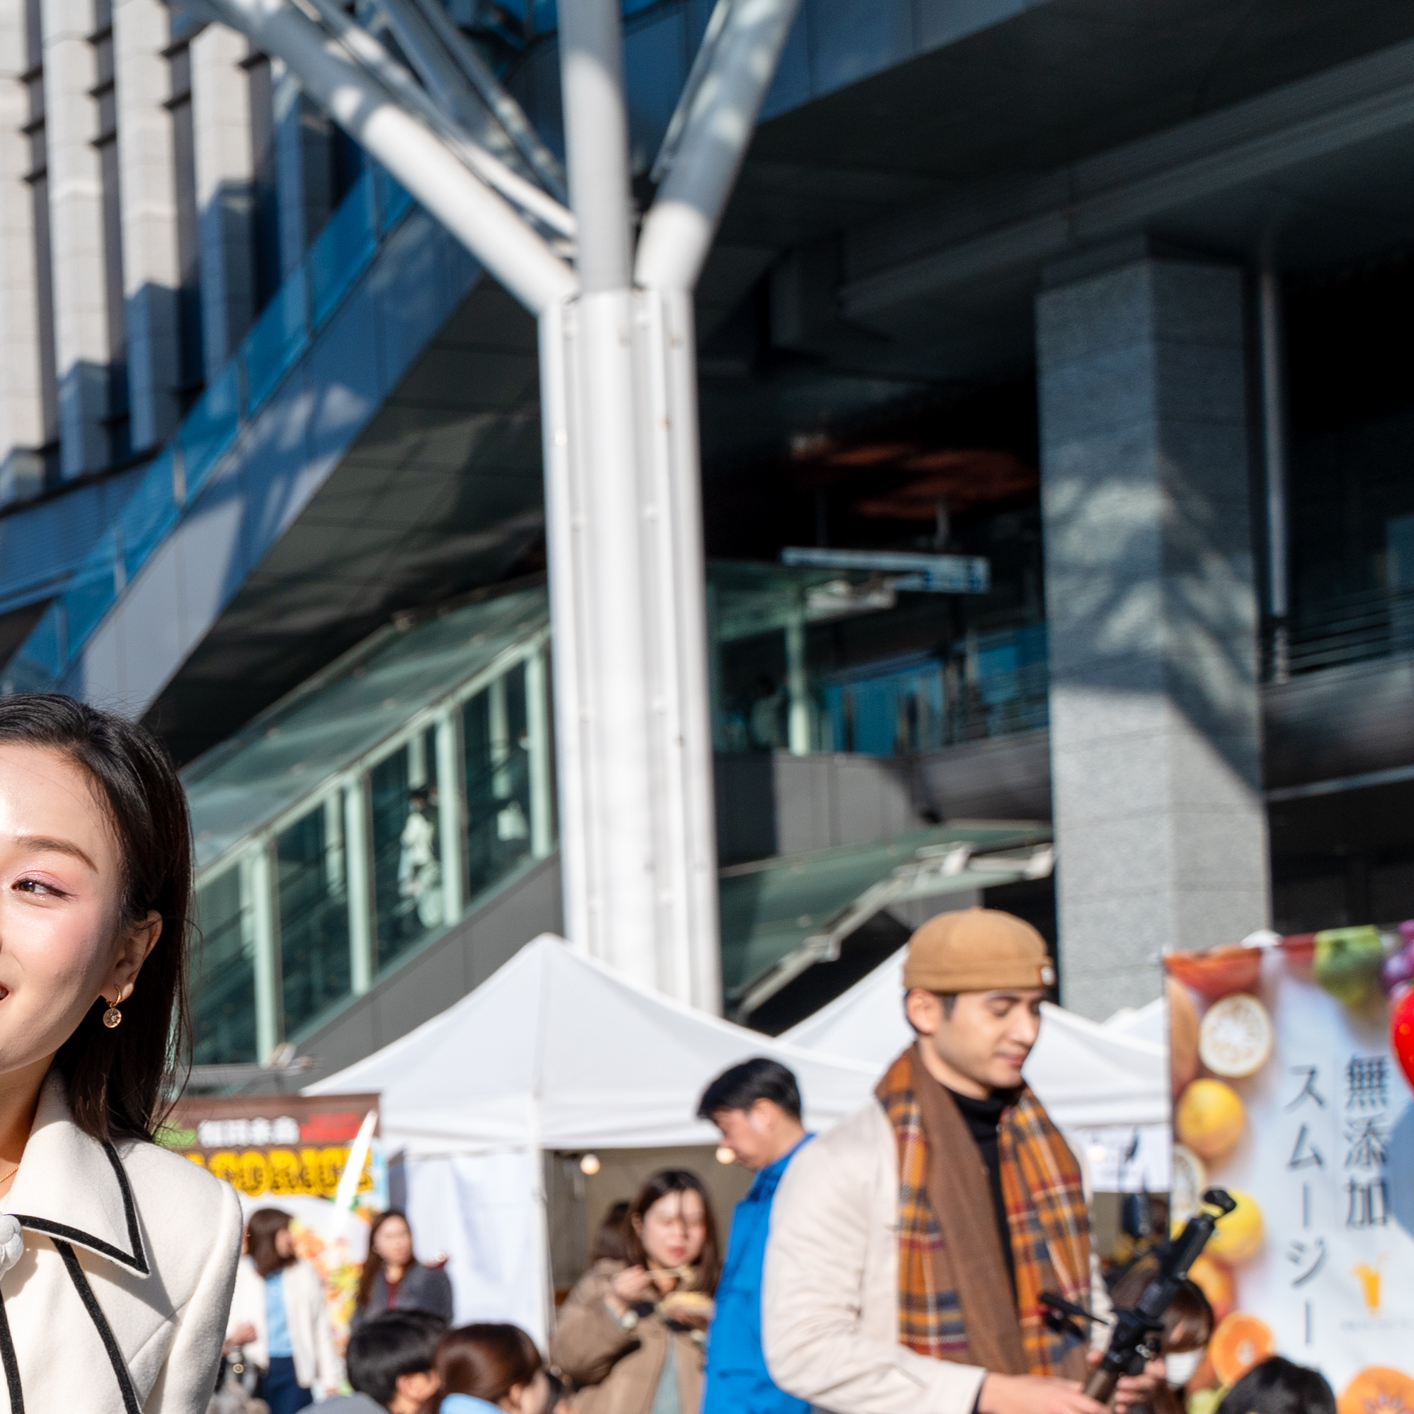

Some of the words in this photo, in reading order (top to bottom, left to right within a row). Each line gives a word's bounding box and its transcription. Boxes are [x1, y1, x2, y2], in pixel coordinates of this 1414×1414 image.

[1284, 1063, 1326, 1347] スムージー
[1344, 1055, 1389, 1230] 無添加
